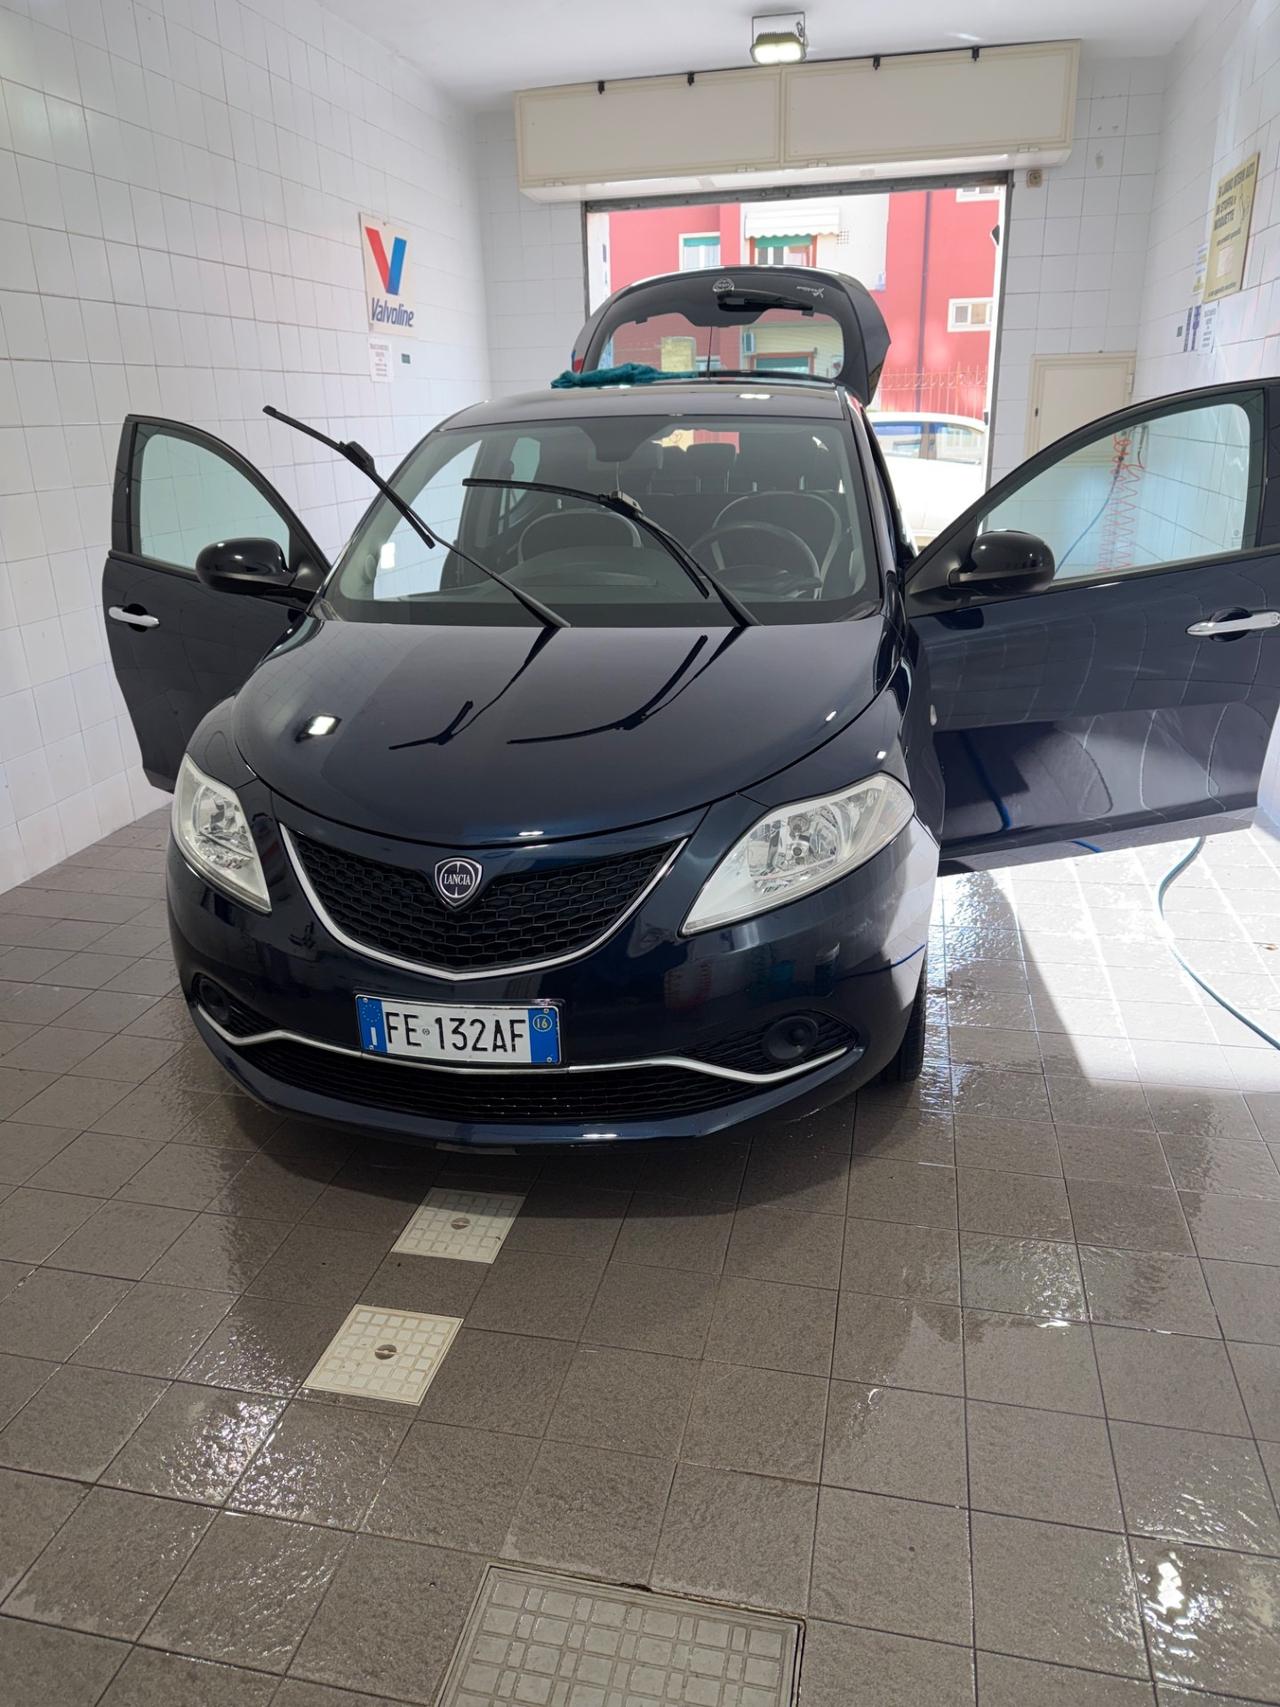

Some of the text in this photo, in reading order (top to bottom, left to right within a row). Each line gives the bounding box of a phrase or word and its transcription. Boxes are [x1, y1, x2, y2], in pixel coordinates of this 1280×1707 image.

[371, 297, 414, 327] Valvoline
[443, 873, 471, 886] LANCIA
[385, 1011, 526, 1053] FE 132AF
[535, 1017, 548, 1029] 16
